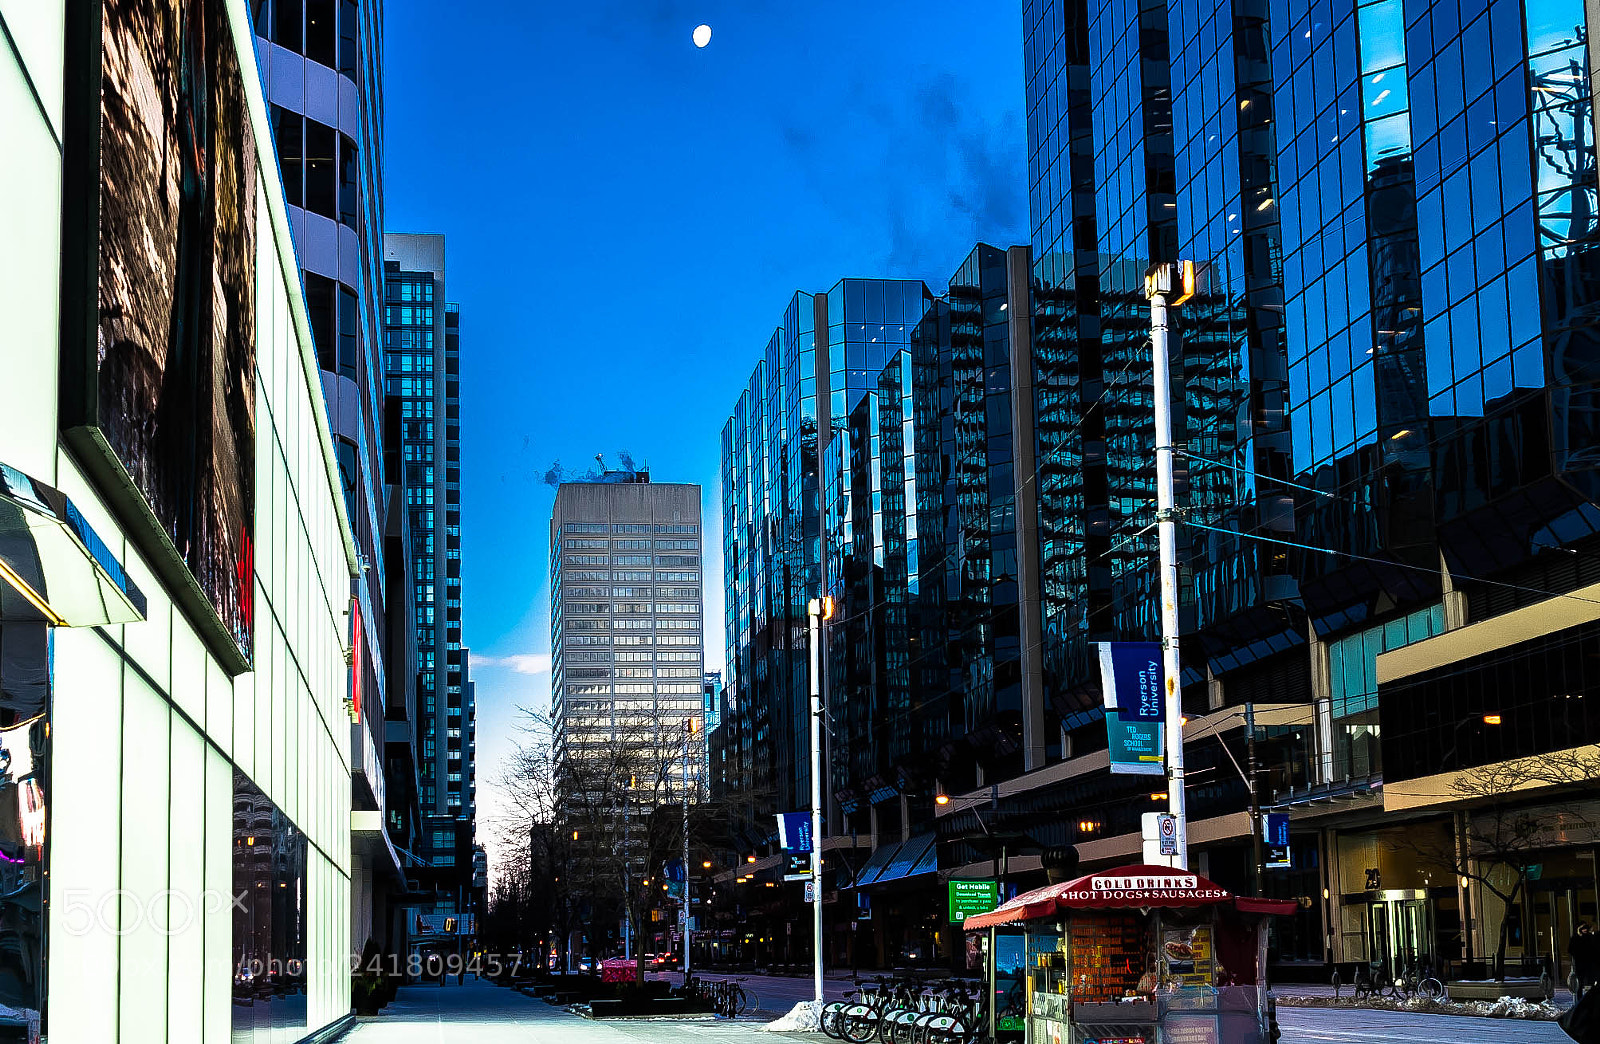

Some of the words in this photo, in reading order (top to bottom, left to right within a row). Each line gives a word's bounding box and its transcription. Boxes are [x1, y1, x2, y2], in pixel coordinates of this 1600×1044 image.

[1139, 670, 1149, 717] Ryerson
[1150, 660, 1159, 717] University
[1126, 725, 1137, 733] TED
[1094, 878, 1132, 890] COLD
[1136, 878, 1194, 889] DRINKS
[1069, 890, 1098, 900] HOT
[1103, 890, 1144, 899] DOGS
[1152, 890, 1221, 899] SAUSAGES
